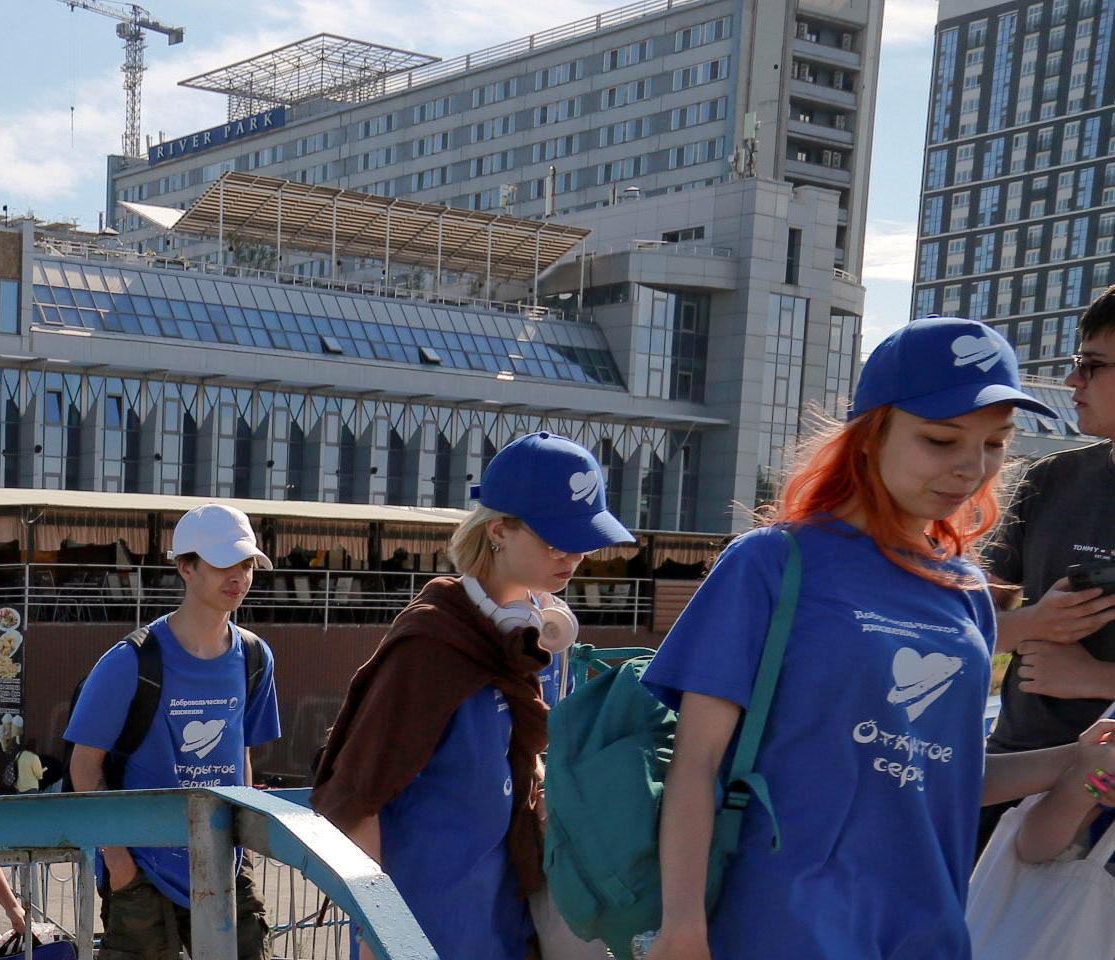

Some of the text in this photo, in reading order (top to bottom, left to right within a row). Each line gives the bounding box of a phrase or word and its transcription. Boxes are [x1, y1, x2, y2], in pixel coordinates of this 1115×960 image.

[157, 111, 273, 158] RIVER PARK
[1073, 544, 1100, 552] TOMMY
